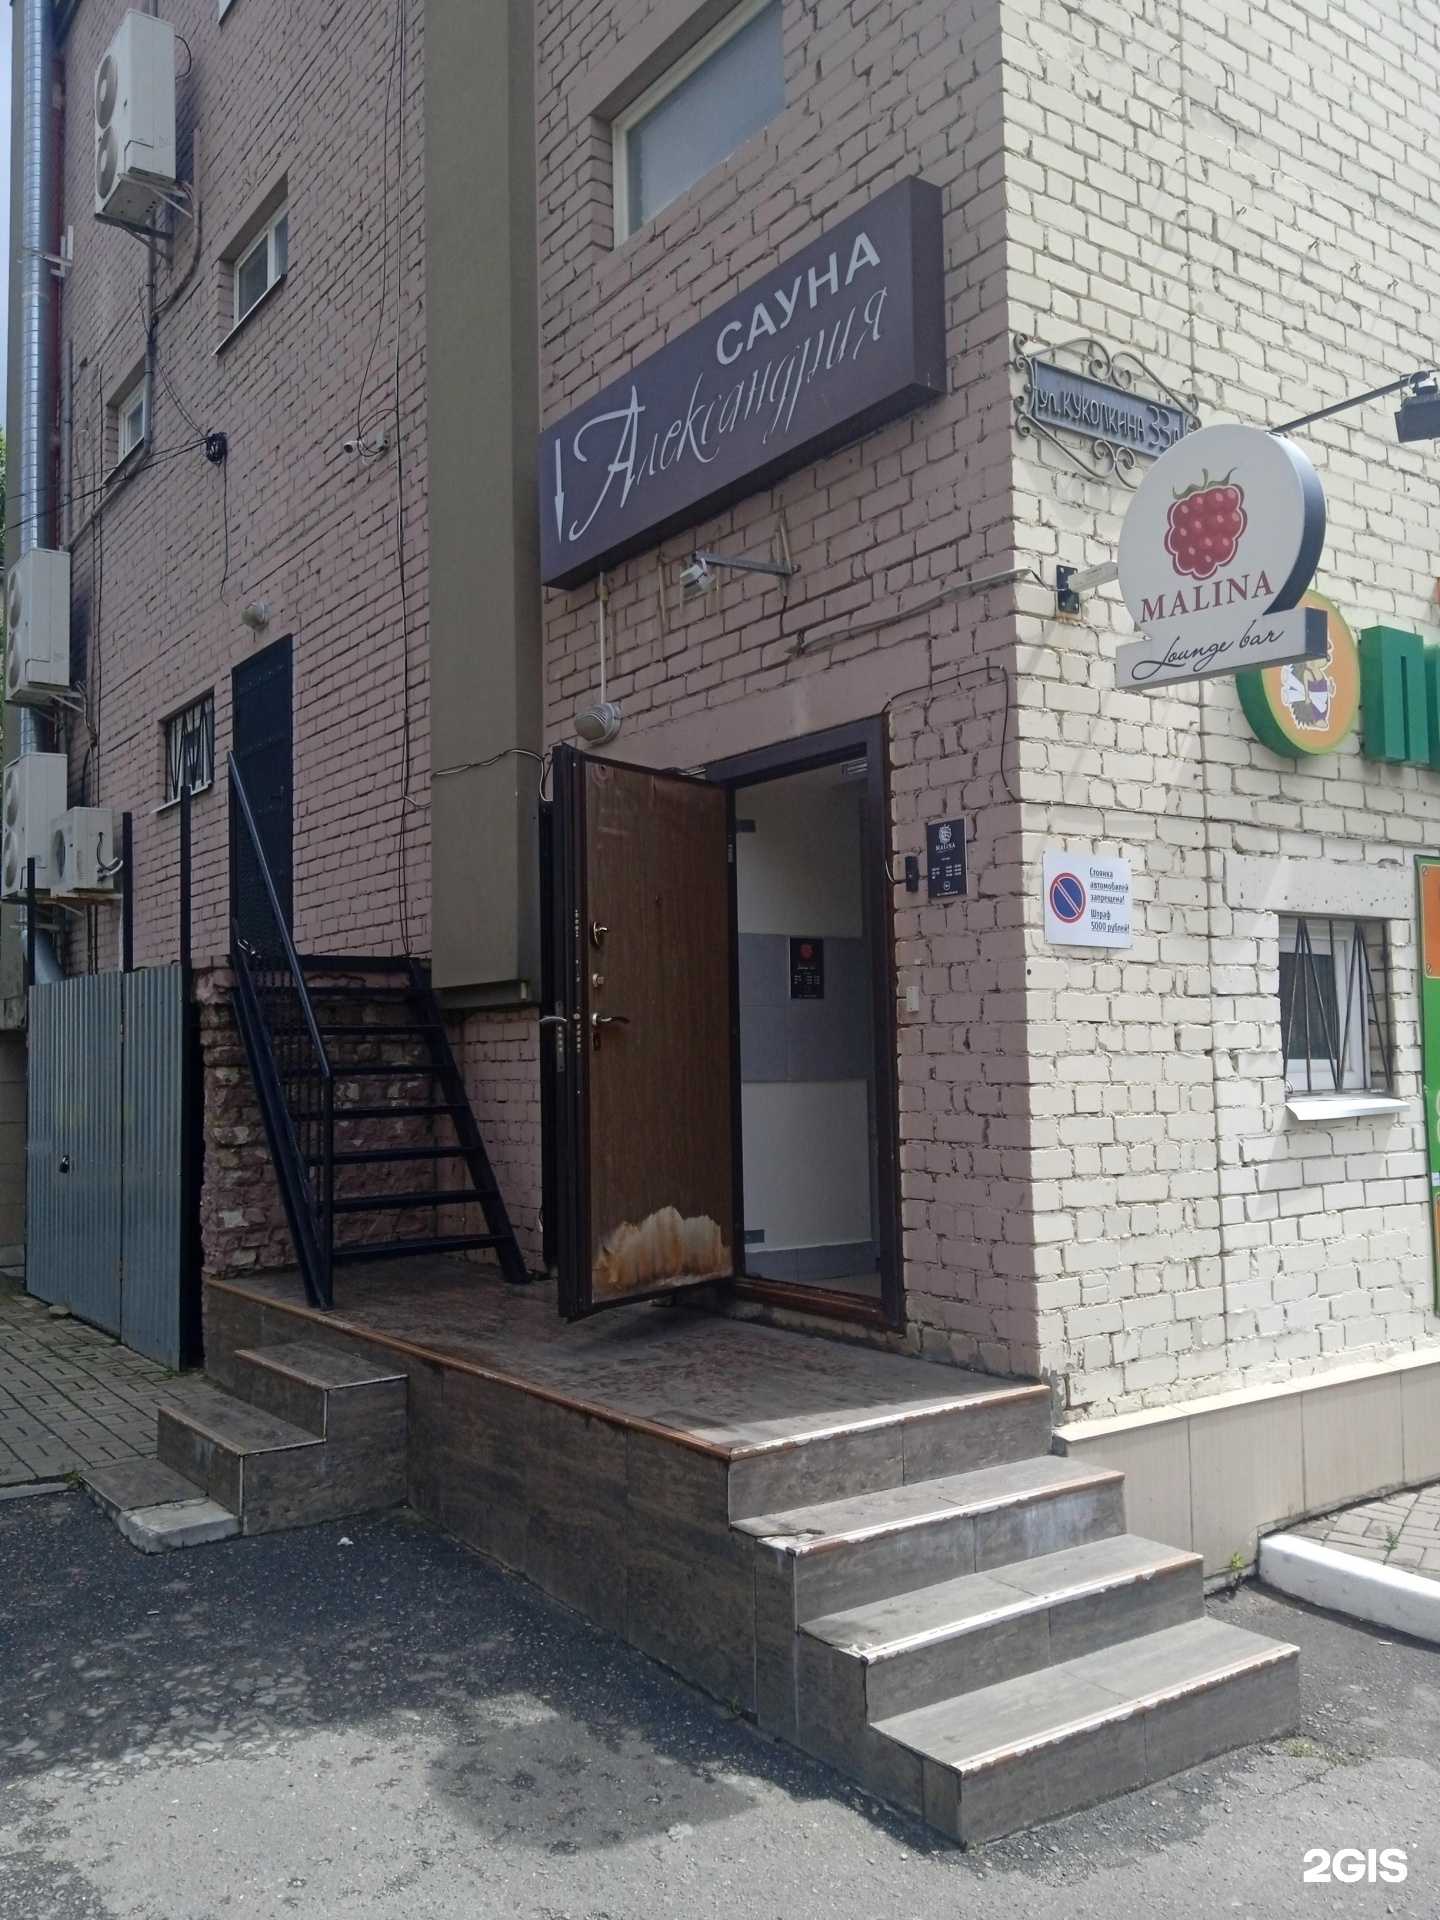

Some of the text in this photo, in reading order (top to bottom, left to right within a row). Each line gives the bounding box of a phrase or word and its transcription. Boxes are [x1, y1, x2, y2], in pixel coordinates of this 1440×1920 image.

[716, 232, 880, 365] САУНА
[569, 287, 887, 541] Александрия
[1140, 570, 1274, 623] MALINA
[1132, 619, 1285, 680] Lounge bar
[1089, 866, 1114, 878] Стоянка
[1090, 881, 1129, 893] автомобилей
[1090, 908, 1111, 920] Штраф
[1091, 920, 1107, 931] 5000
